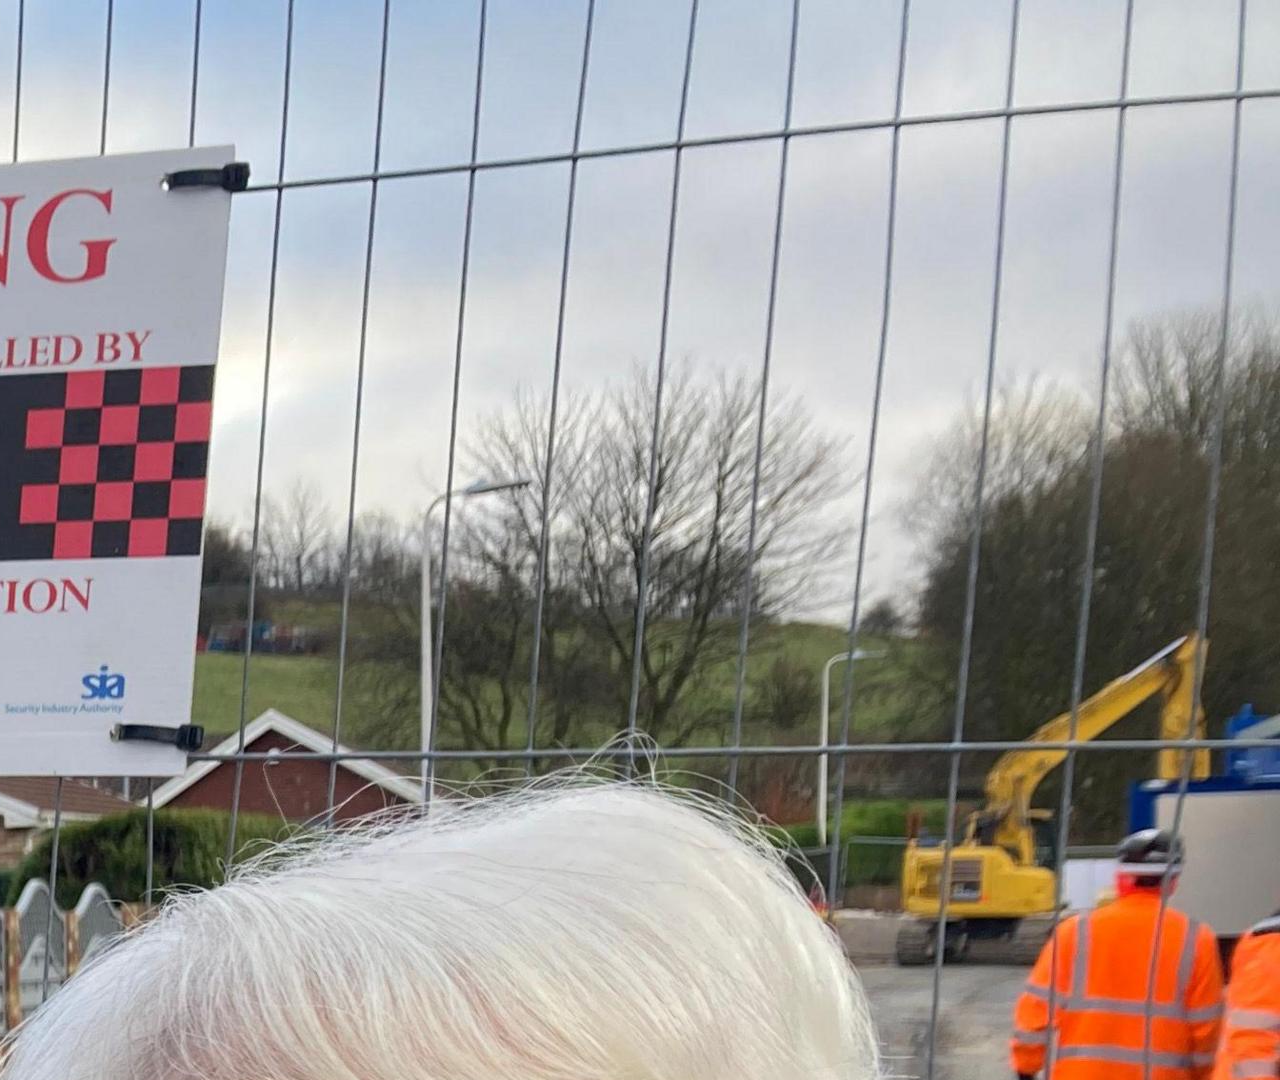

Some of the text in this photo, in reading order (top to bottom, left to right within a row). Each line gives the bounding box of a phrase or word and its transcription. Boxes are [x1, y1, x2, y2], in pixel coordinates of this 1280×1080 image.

[94, 330, 153, 364] BY
[80, 664, 126, 700] sia
[4, 703, 124, 715] Security Industry Authority
